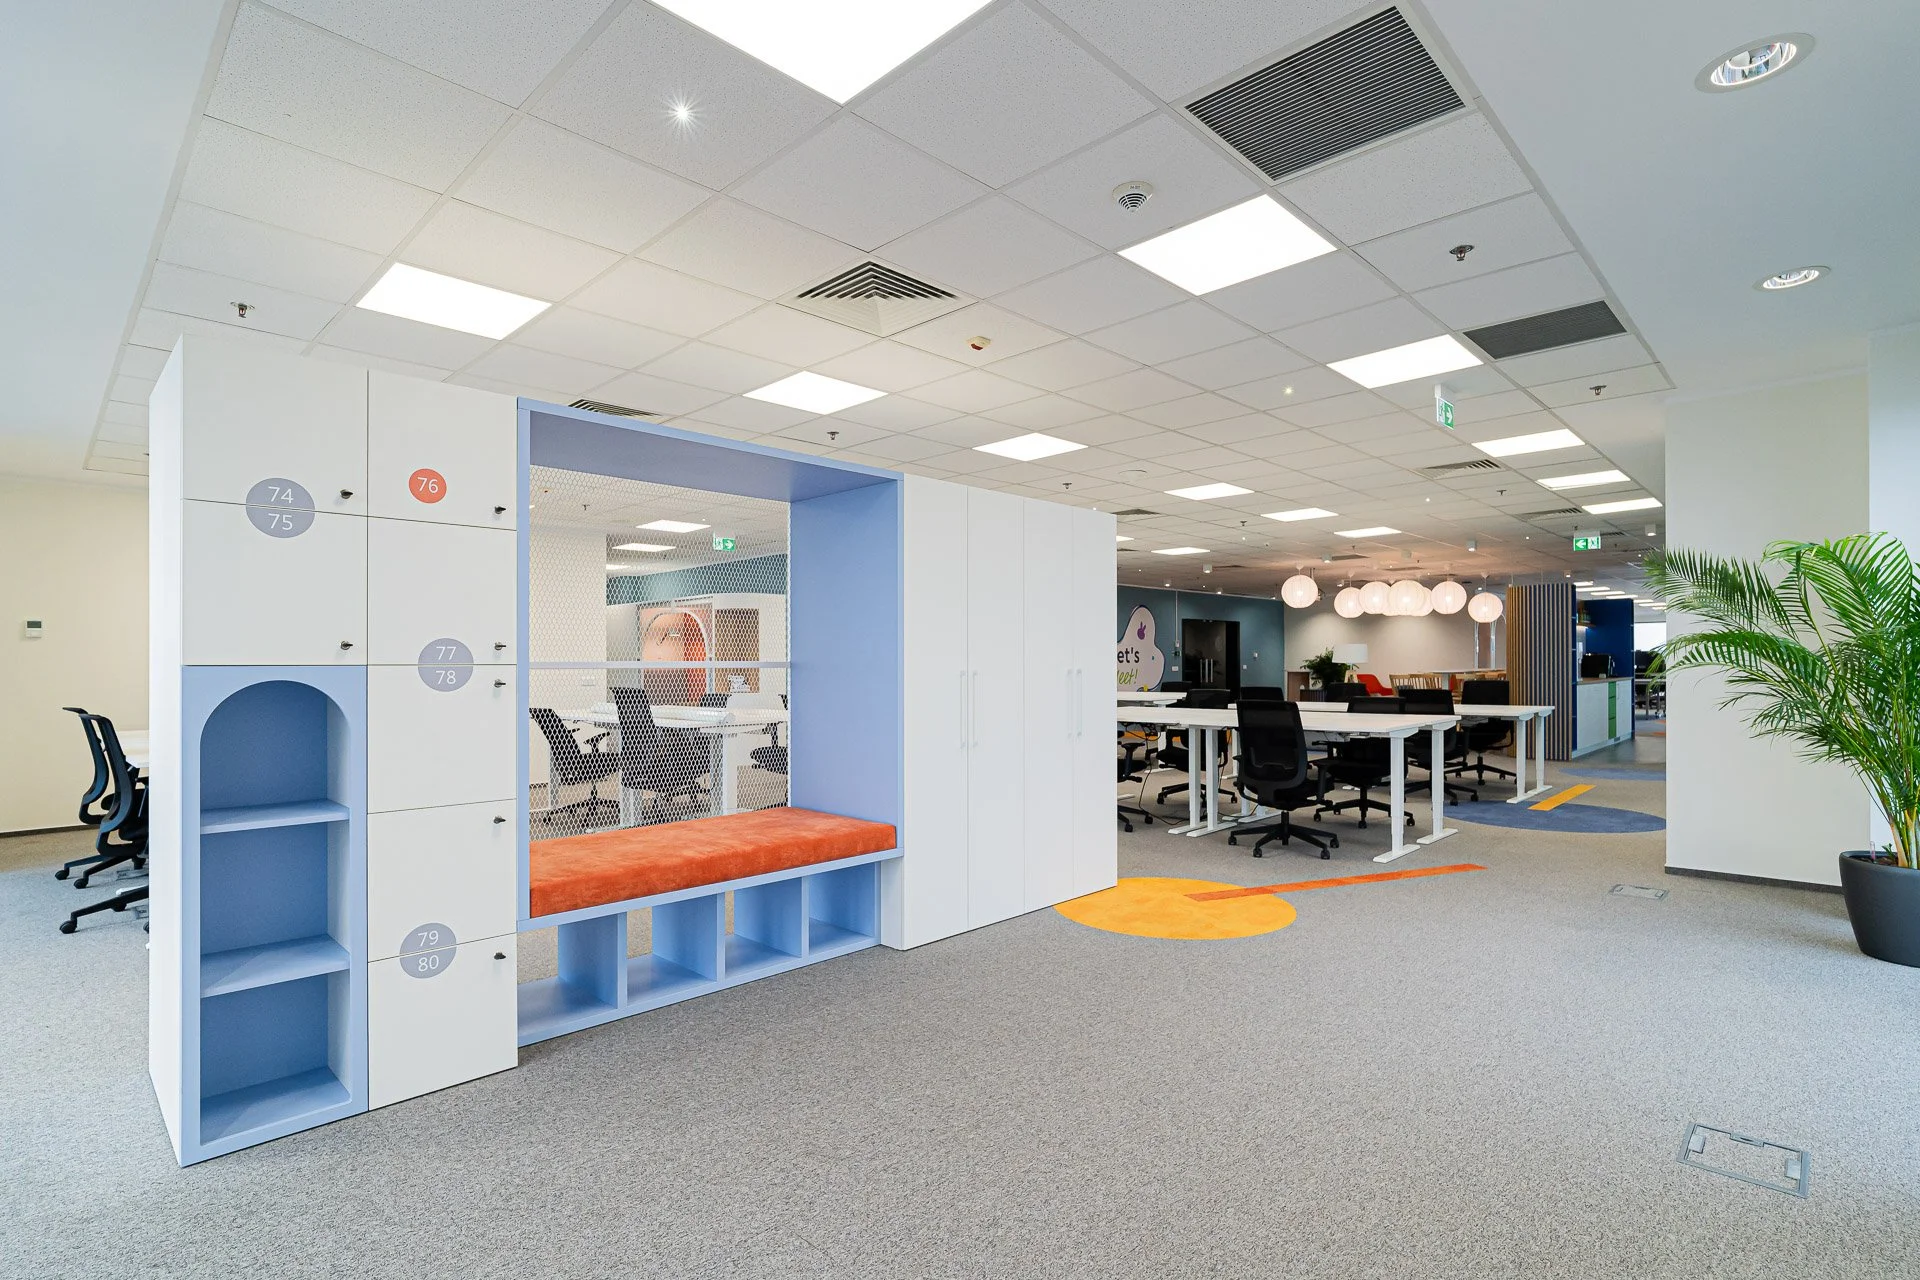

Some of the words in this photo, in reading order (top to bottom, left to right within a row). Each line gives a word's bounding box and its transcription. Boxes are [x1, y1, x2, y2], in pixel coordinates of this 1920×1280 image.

[417, 476, 439, 493] 76
[268, 486, 294, 504] 74
[268, 513, 293, 530] 75
[436, 646, 457, 661] 77
[1117, 647, 1140, 663] et's
[435, 670, 456, 685] 78
[417, 930, 439, 947] 79
[418, 955, 439, 972] 80
